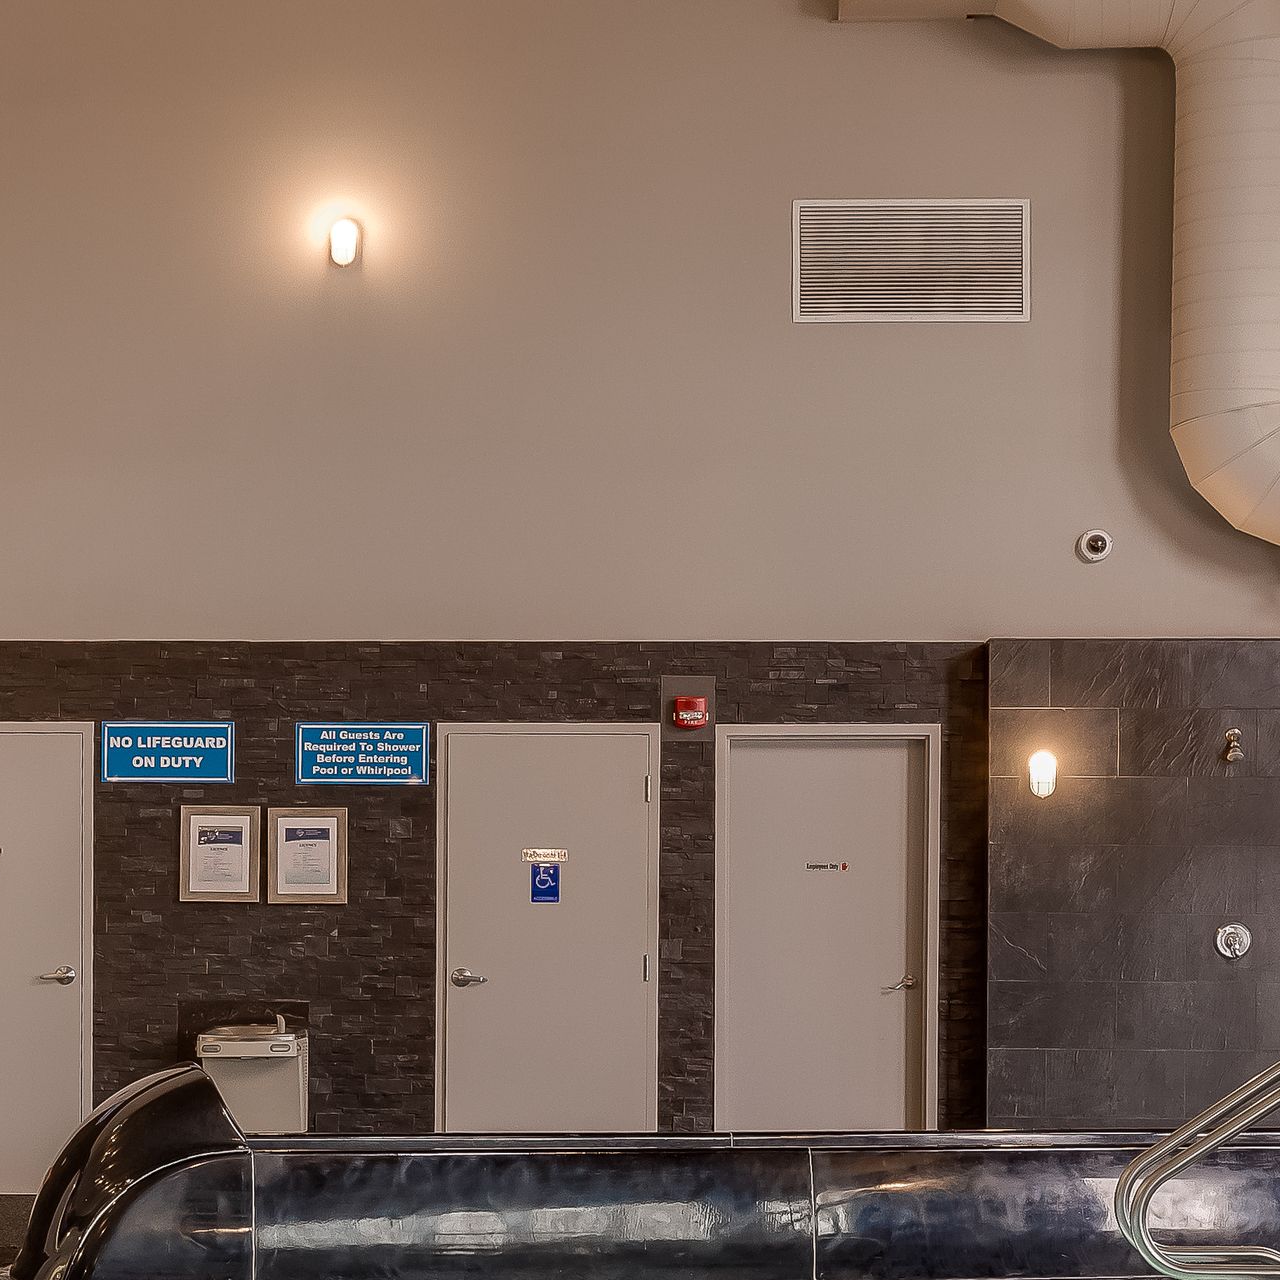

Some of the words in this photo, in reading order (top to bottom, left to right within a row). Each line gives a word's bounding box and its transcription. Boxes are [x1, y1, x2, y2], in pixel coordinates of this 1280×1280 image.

[320, 730, 336, 740] All
[339, 730, 380, 740] Guests
[383, 731, 404, 740] Are
[109, 736, 133, 748] NO
[137, 736, 227, 748] LIFEGUARD
[304, 742, 356, 753] Required
[359, 742, 374, 751] To
[377, 743, 422, 752] Shower
[132, 756, 155, 768] ON
[160, 756, 203, 768] DUTY
[316, 754, 355, 763] Before
[358, 754, 408, 765] Entering
[312, 766, 338, 775] Pool
[341, 767, 353, 775] or
[356, 766, 412, 776] Whirlpool
